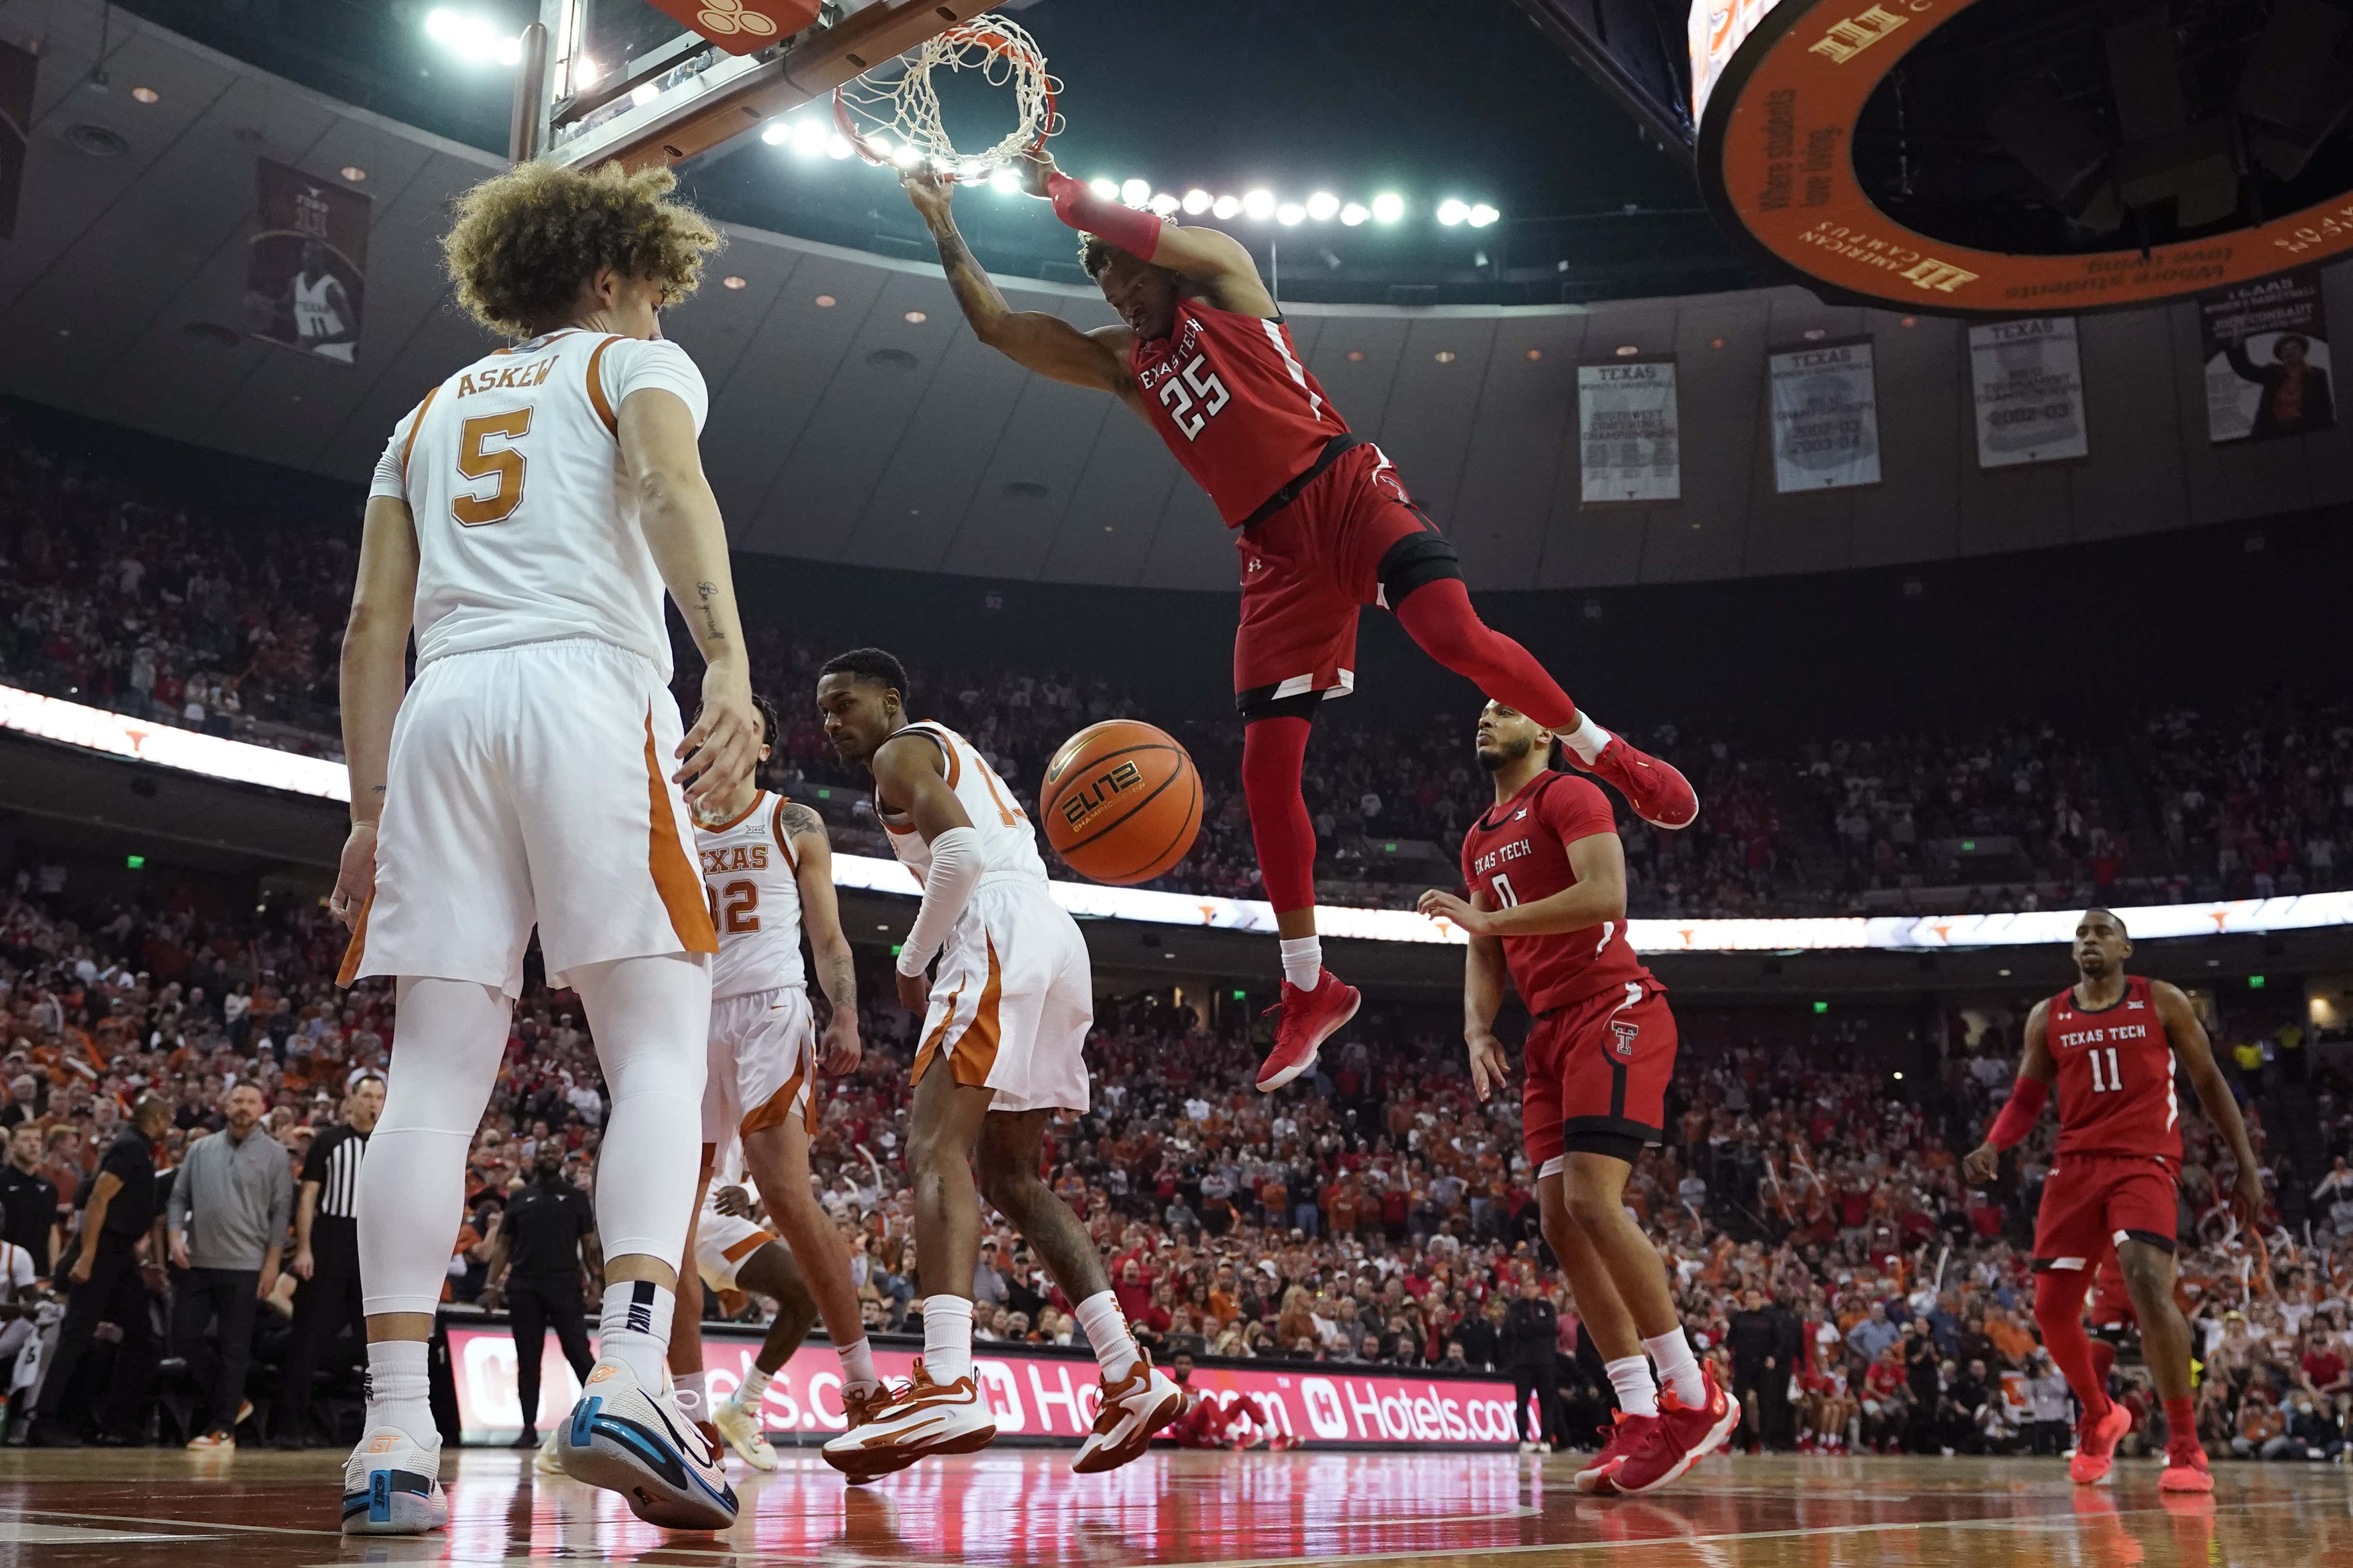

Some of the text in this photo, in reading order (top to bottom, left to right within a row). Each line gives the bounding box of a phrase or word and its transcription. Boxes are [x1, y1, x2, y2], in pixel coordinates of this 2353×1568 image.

[1816, 221, 1920, 262] CAMPUS
[1138, 354, 1179, 390] EXAS
[1178, 318, 1204, 359] TECH
[1599, 364, 1657, 381] TEXAS
[458, 355, 560, 399] ASKEW
[1159, 353, 1231, 442] 25
[451, 406, 533, 527] 5
[1061, 760, 1143, 827] ELITE
[1474, 839, 1532, 877] EXAS TECH
[1491, 873, 1518, 910] 0
[2060, 1024, 2147, 1048] TEXAS TECH
[2088, 1047, 2123, 1092] 11
[369, 1436, 402, 1454] GT
